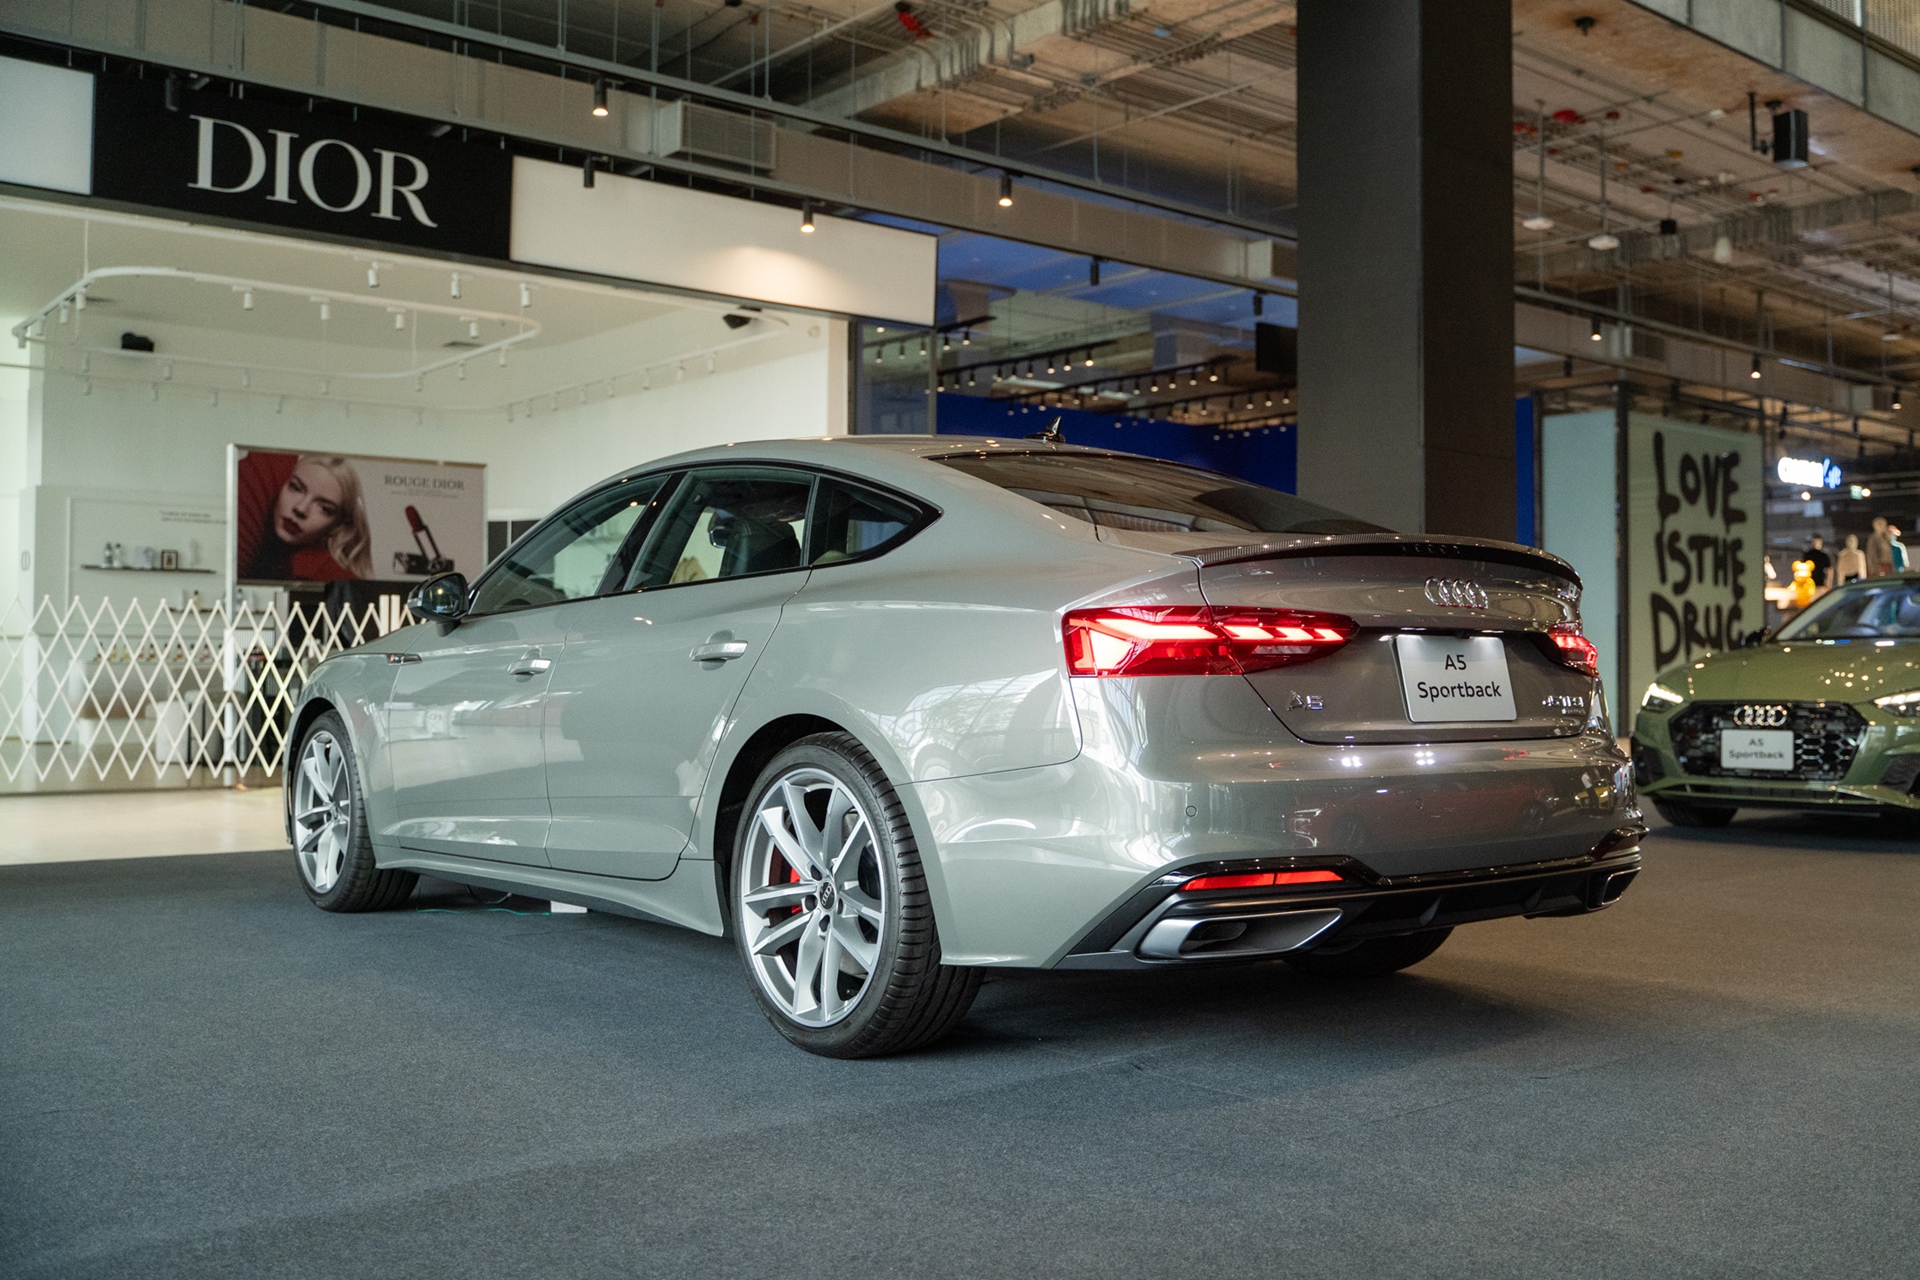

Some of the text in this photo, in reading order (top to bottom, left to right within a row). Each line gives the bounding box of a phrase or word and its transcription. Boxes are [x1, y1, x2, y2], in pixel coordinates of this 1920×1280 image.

[187, 114, 438, 228] DIOR
[384, 474, 464, 490] ROUGE DIOR
[1653, 430, 1748, 530] LOVE
[1650, 592, 1744, 672] DRUG
[1444, 654, 1467, 670] A5
[1417, 681, 1502, 702] Sportback
[1748, 738, 1764, 747] A5
[1728, 749, 1784, 760] Sportback
